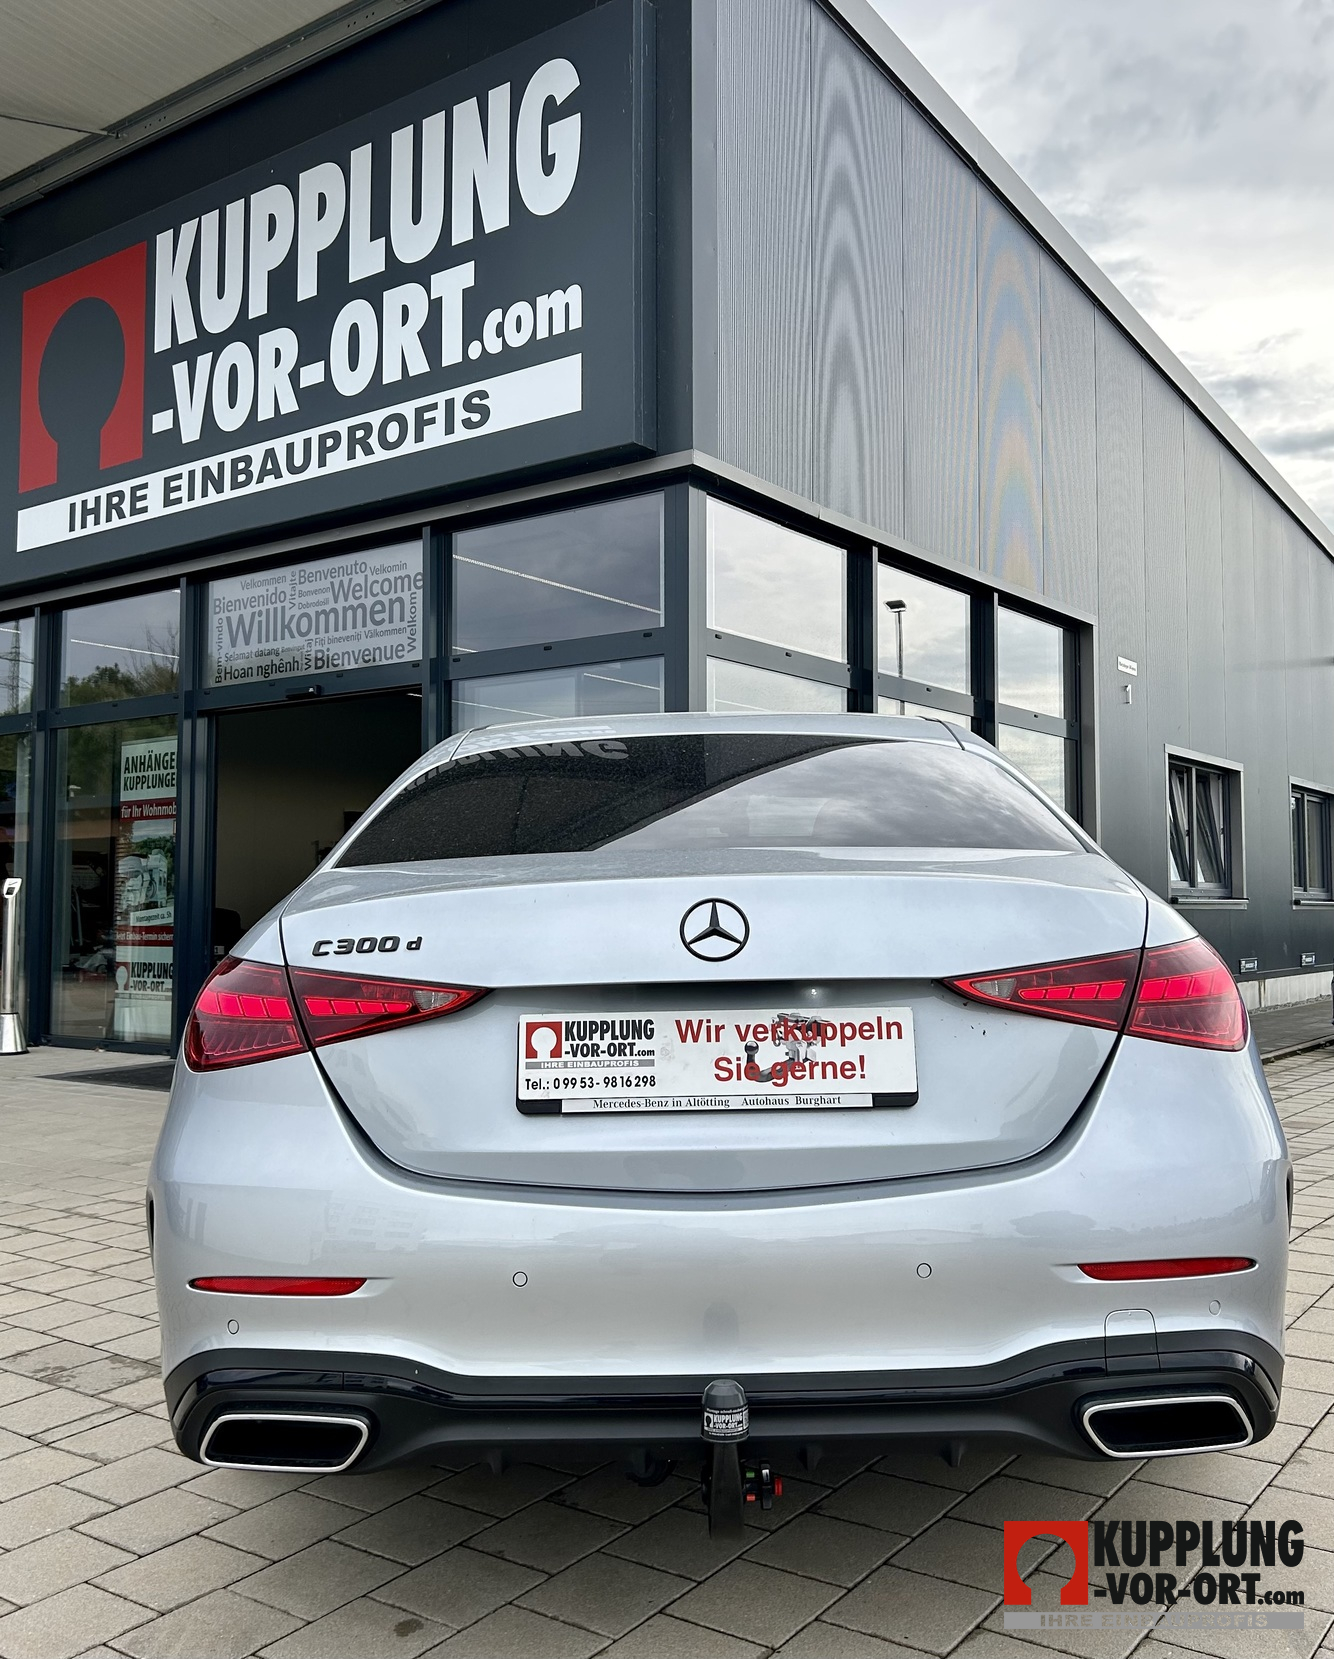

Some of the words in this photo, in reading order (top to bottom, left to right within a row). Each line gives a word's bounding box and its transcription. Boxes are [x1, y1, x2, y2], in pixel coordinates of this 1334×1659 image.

[154, 58, 582, 354] KUPPLUNG
[68, 482, 149, 532] IHRE
[163, 390, 492, 508] EINBAUPROFIS
[298, 560, 367, 585] Benvenuto
[369, 561, 407, 576] Velkomin
[240, 575, 287, 590] Velkommen
[289, 570, 297, 610] Vitajte
[330, 571, 423, 604] Welcome
[213, 586, 288, 615] Bienvenido
[226, 597, 405, 649] Willkommen
[363, 626, 407, 639] Välkommen
[407, 591, 417, 653] Welkom
[214, 617, 224, 683] Bem-vindo
[254, 647, 280, 657] datang
[304, 638, 313, 671] Witaj
[314, 643, 405, 670] Bienvenue
[224, 665, 253, 680] Hoan
[256, 656, 299, 678] nghênh
[1126, 684, 1132, 704] 1
[124, 750, 177, 774] ANHÄNGE
[123, 772, 177, 791] KUPPLUNGE
[121, 806, 131, 818] für
[132, 805, 141, 817] Ihr
[406, 936, 423, 950] d
[564, 1019, 655, 1041] KUPPLUNG
[675, 1019, 725, 1043] Wir
[734, 1016, 903, 1047] verkuppeln
[564, 1042, 655, 1058] -VOR-ORT.com
[567, 1060, 640, 1068] EINBAUPROFIS
[714, 1056, 761, 1081] Sie
[771, 1054, 866, 1087] gerne!
[525, 1078, 550, 1090] Tel.:
[593, 1099, 669, 1109] Mercedes-Benz
[672, 1098, 682, 1107] in
[685, 1097, 730, 1109] Altötting
[741, 1096, 790, 1106] Autohaus
[795, 1095, 842, 1107] Burghart
